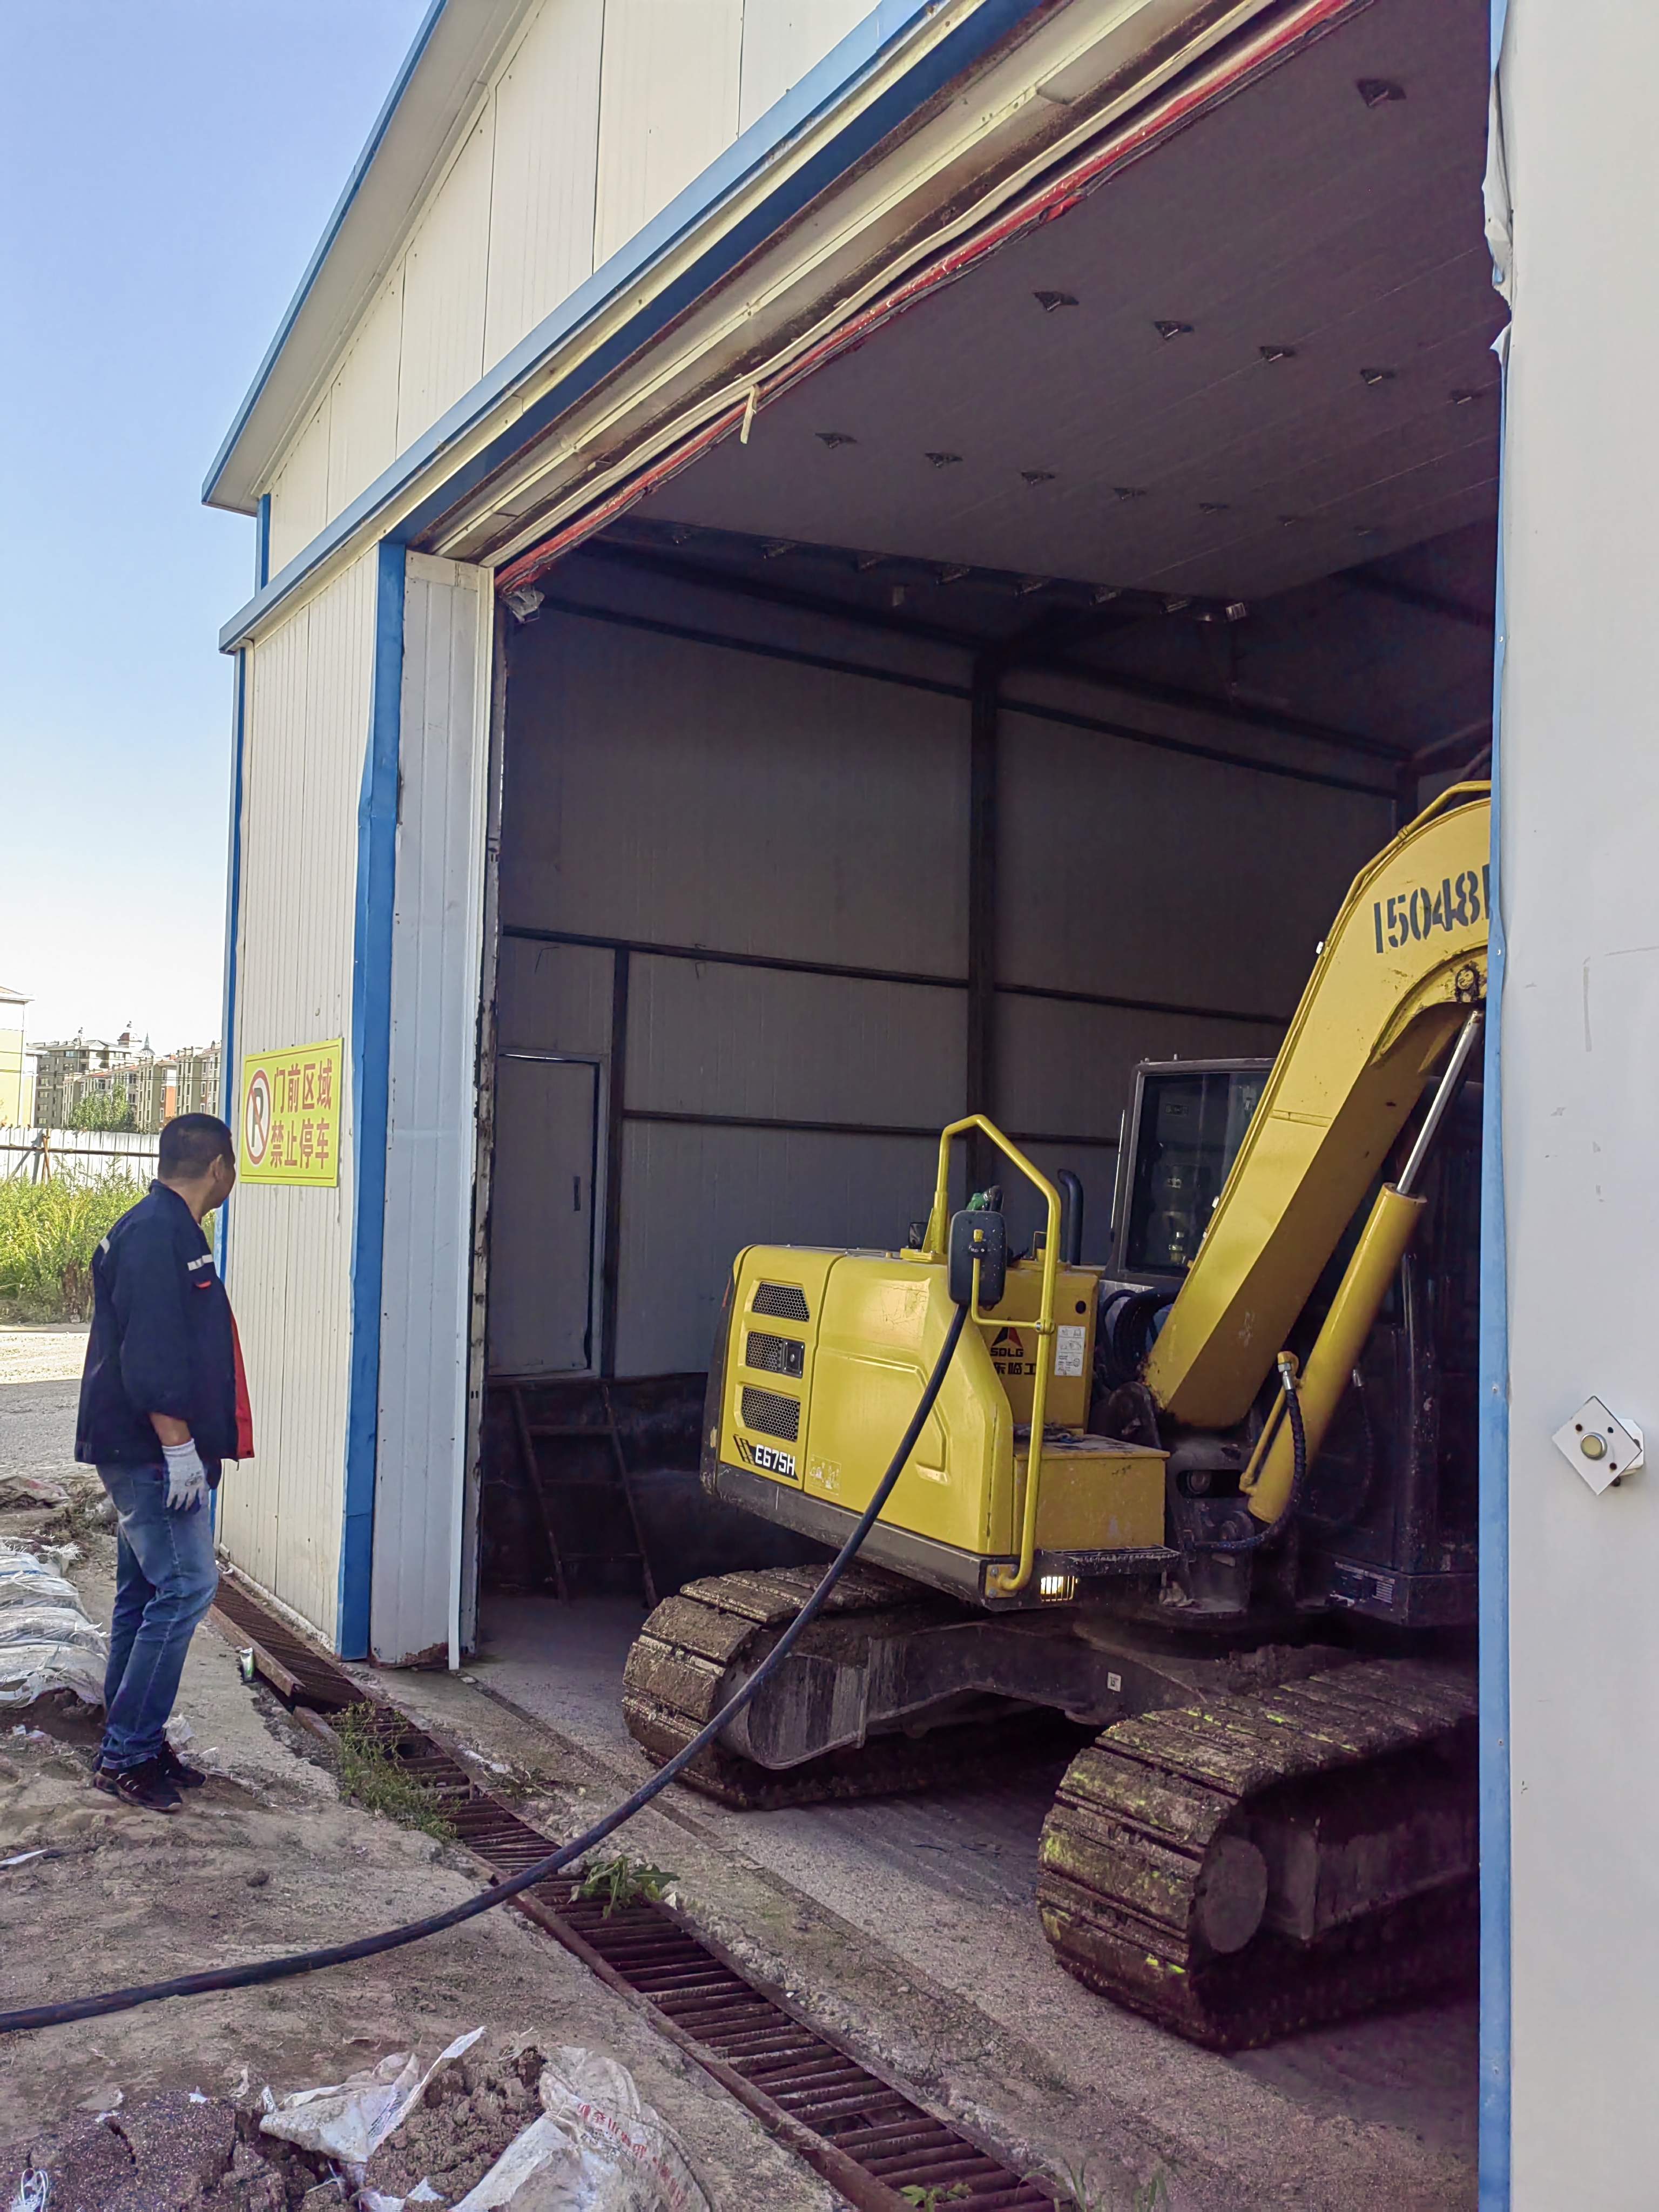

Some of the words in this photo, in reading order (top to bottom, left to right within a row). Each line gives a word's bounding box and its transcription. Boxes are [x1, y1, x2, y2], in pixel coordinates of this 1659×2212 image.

[273, 1058, 332, 1114] 门前区域
[270, 1117, 330, 1169] 禁止停车
[990, 1347, 1024, 1357] SDLG
